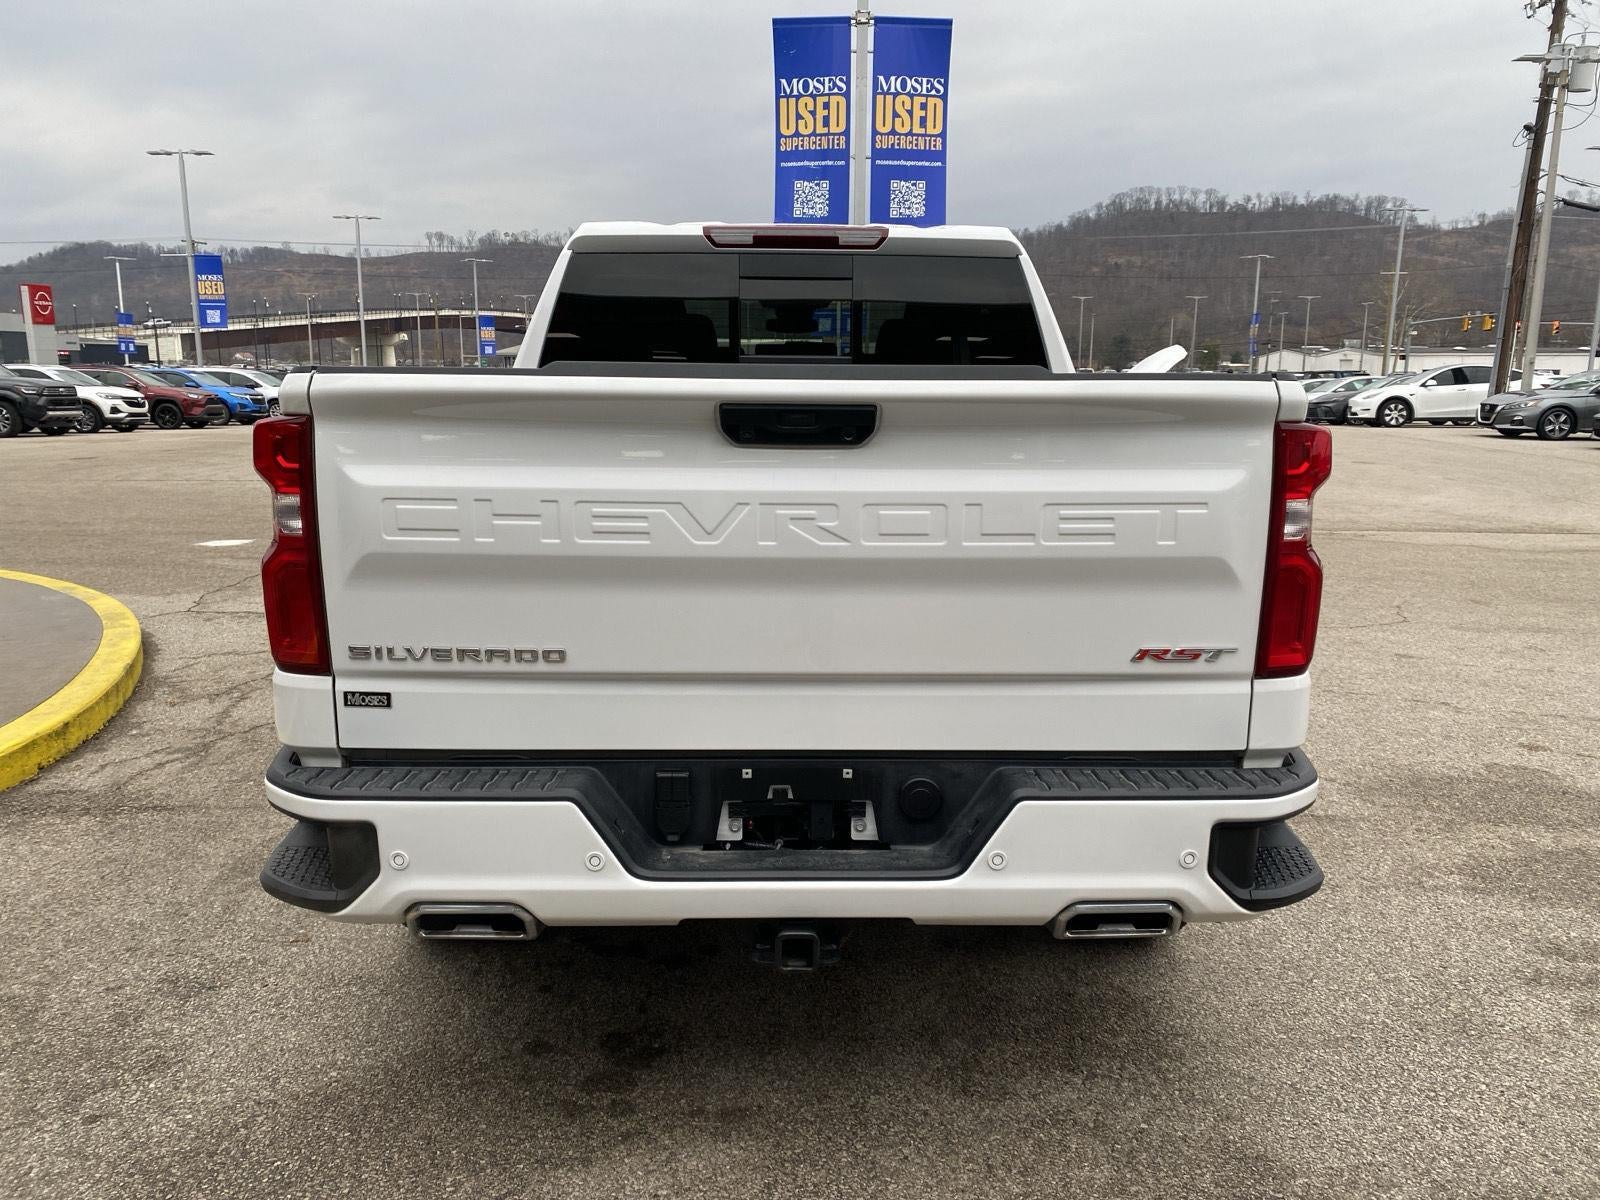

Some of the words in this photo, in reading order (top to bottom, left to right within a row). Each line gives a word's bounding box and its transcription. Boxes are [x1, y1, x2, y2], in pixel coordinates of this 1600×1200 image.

[779, 76, 847, 95] MOSES
[876, 75, 945, 95] MOSES
[779, 95, 847, 136] USED
[875, 94, 944, 135] USED
[780, 135, 846, 151] SUPERCENTER
[875, 135, 942, 150] SUPERCENTER
[198, 281, 225, 295] USED
[381, 497, 1209, 545] CHEVROLET
[348, 645, 566, 663] SILVERADO
[1130, 647, 1238, 663] RST
